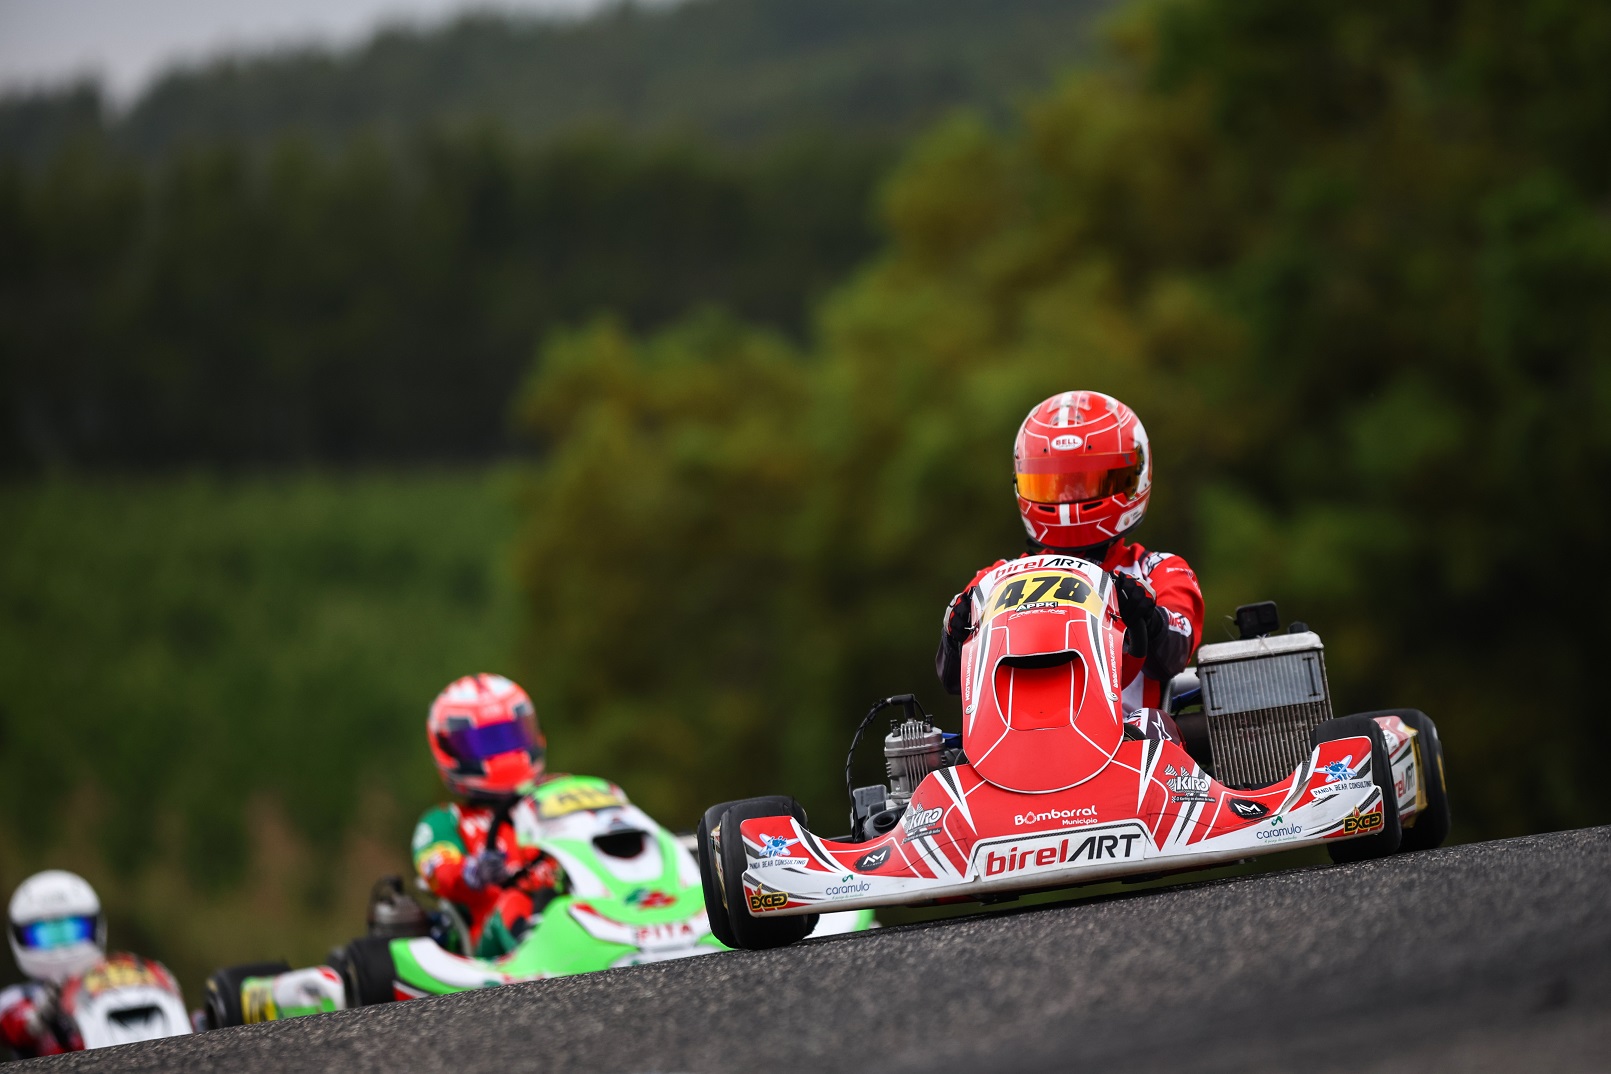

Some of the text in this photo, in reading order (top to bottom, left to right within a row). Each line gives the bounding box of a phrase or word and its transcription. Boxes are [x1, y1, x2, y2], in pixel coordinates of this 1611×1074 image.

[1055, 438, 1078, 446] BELL
[994, 557, 1089, 580] birelART
[994, 576, 1092, 611] 478
[1176, 776, 1210, 792] KIRO
[1313, 780, 1373, 796] PANDA BEAR CONSULTING
[909, 807, 944, 830] KIRO
[1014, 805, 1098, 826] Bombarral
[1256, 823, 1302, 840] caramulo
[762, 860, 774, 869] BEAR
[774, 858, 807, 867] CONSULTING
[985, 833, 1141, 877] birelART
[825, 880, 870, 896] caramulo
